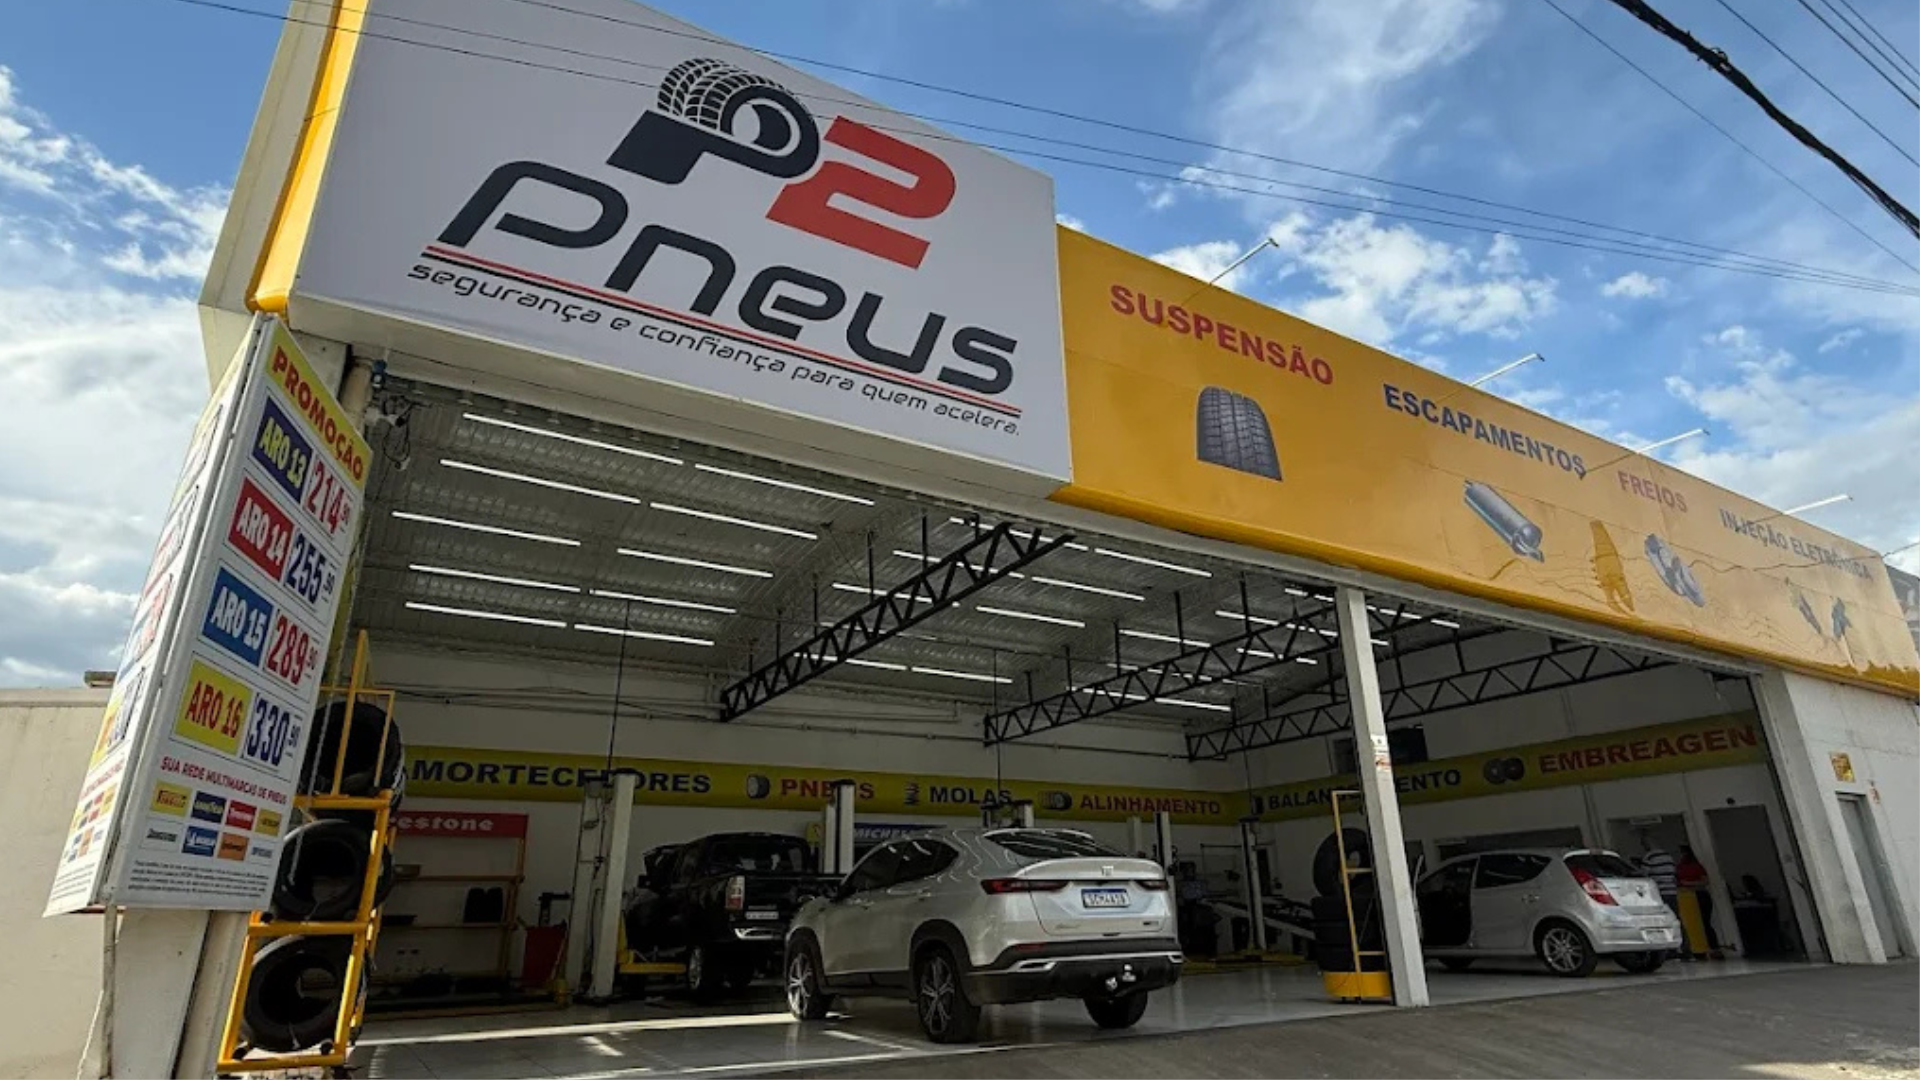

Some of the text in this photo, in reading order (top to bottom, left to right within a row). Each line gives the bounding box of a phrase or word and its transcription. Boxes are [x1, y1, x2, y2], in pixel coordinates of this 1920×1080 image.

[436, 160, 1018, 395] Pneus
[407, 264, 1020, 436] segurança e confiança para quem acelera.
[1110, 284, 1334, 386] SUSPENSÃO
[271, 345, 363, 481] PROMOÇÃO
[1383, 383, 1587, 479] ESCAPAMENTOS
[258, 416, 290, 471] ARO
[286, 447, 308, 489] 13
[306, 459, 345, 534] 214
[1618, 469, 1688, 513] FREIOS
[236, 496, 270, 551] ARO
[266, 523, 288, 566] 14
[286, 532, 326, 605] 255
[210, 585, 248, 638] ARO
[243, 608, 267, 651] 15
[266, 613, 309, 686] 289
[160, 756, 181, 774] SUA
[185, 680, 223, 730] ARO
[221, 697, 243, 738] 16
[247, 698, 290, 767] 330
[1540, 725, 1758, 774] EMBREAGEN
[781, 779, 875, 799] PNES
[929, 785, 1013, 806] MOLAS
[1079, 793, 1221, 815] ALINHAMENTO
